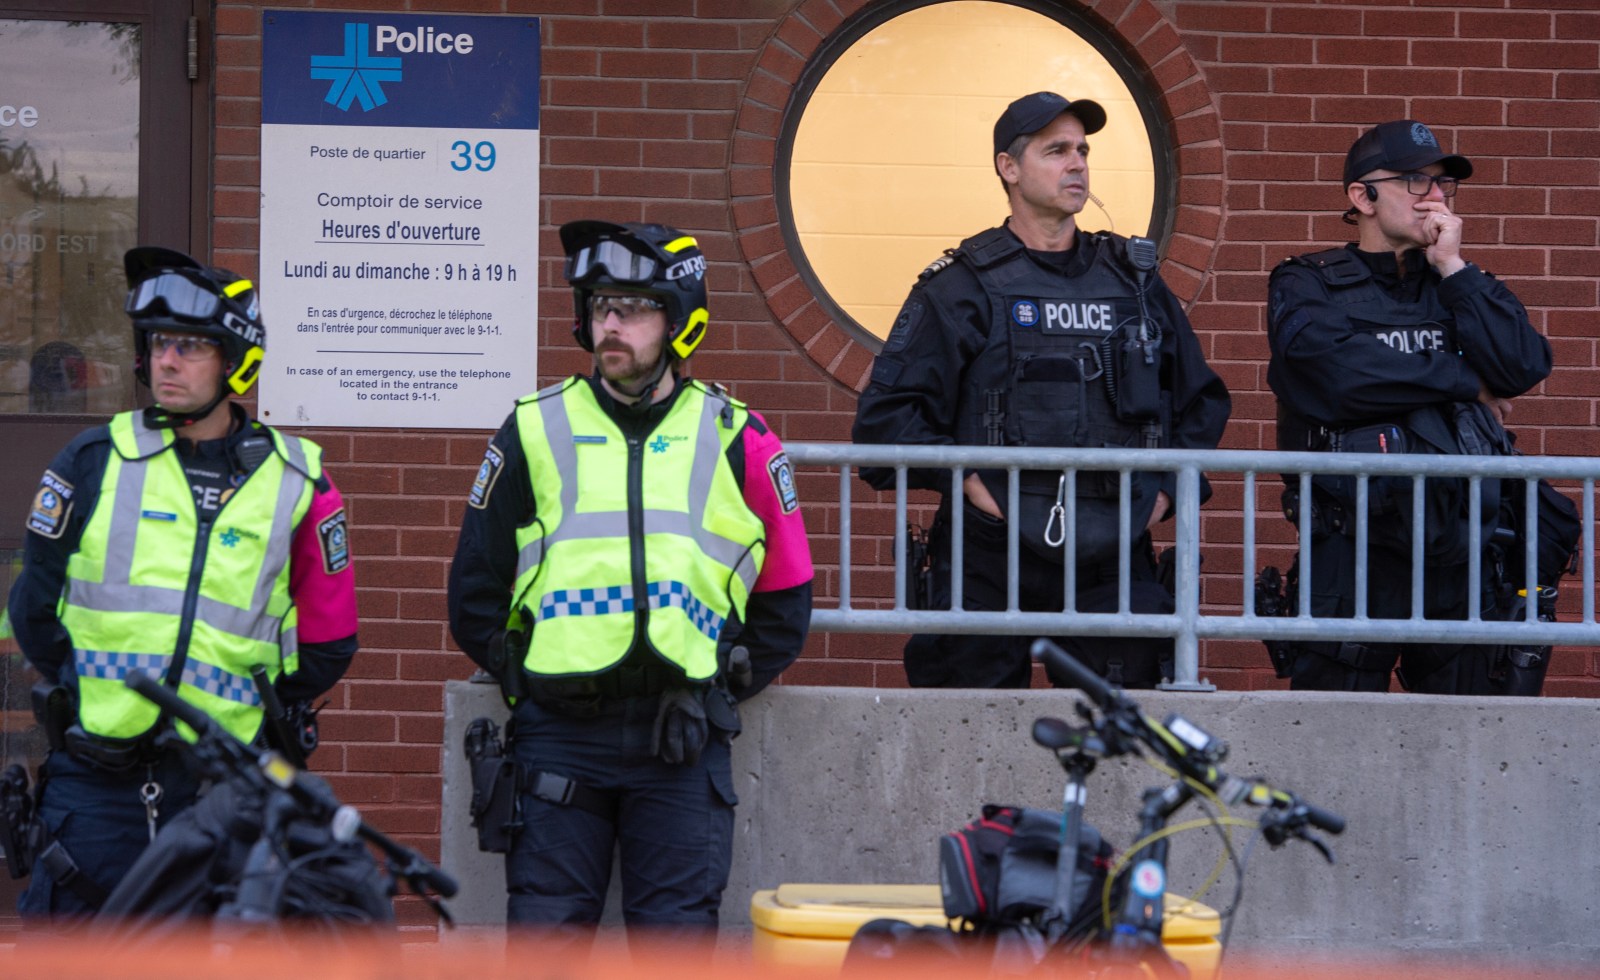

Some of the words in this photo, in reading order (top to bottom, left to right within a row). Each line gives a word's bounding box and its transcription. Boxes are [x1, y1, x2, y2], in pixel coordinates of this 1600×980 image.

[376, 24, 474, 55] Police
[309, 145, 349, 159] Poste
[351, 146, 370, 159] de
[373, 147, 426, 162] quartier
[450, 140, 497, 172] 39
[316, 192, 394, 211] Comptoir
[398, 194, 420, 209] de
[424, 195, 483, 210] service
[321, 219, 381, 239] Heures
[385, 220, 481, 241] d'ouverture
[56, 234, 98, 253] EST
[284, 260, 328, 279] Lundi
[332, 264, 351, 279] au
[355, 261, 430, 281] dimanche
[444, 263, 453, 281] 9
[458, 263, 467, 281] h
[472, 264, 481, 282] à
[485, 264, 503, 282] 19
[507, 264, 517, 282] h
[307, 306, 320, 318] En
[321, 309, 338, 319] cas
[339, 307, 388, 321] d'urgence,
[389, 308, 436, 320] décrochez
[437, 308, 447, 320] le
[448, 309, 493, 323] téléphone
[1044, 302, 1113, 331] POLICE
[296, 322, 320, 333] dans
[321, 322, 355, 334] l'entrée
[356, 325, 378, 336] pour
[380, 324, 443, 337] communiquer
[443, 325, 465, 336] avec
[467, 324, 476, 336] le
[477, 324, 503, 336] 9-1-1.
[286, 366, 297, 376] In
[299, 367, 324, 376] case
[326, 366, 338, 377] of
[339, 368, 353, 377] an
[355, 368, 416, 380] emergency,
[418, 369, 438, 378] use
[440, 368, 457, 378] the
[459, 369, 512, 380] telephone
[339, 379, 378, 389] located
[380, 380, 391, 389] in
[393, 380, 410, 390] the
[412, 381, 459, 390] entrance
[356, 392, 368, 401] to
[370, 392, 410, 402] contact
[411, 392, 441, 402] 9-1-1.
